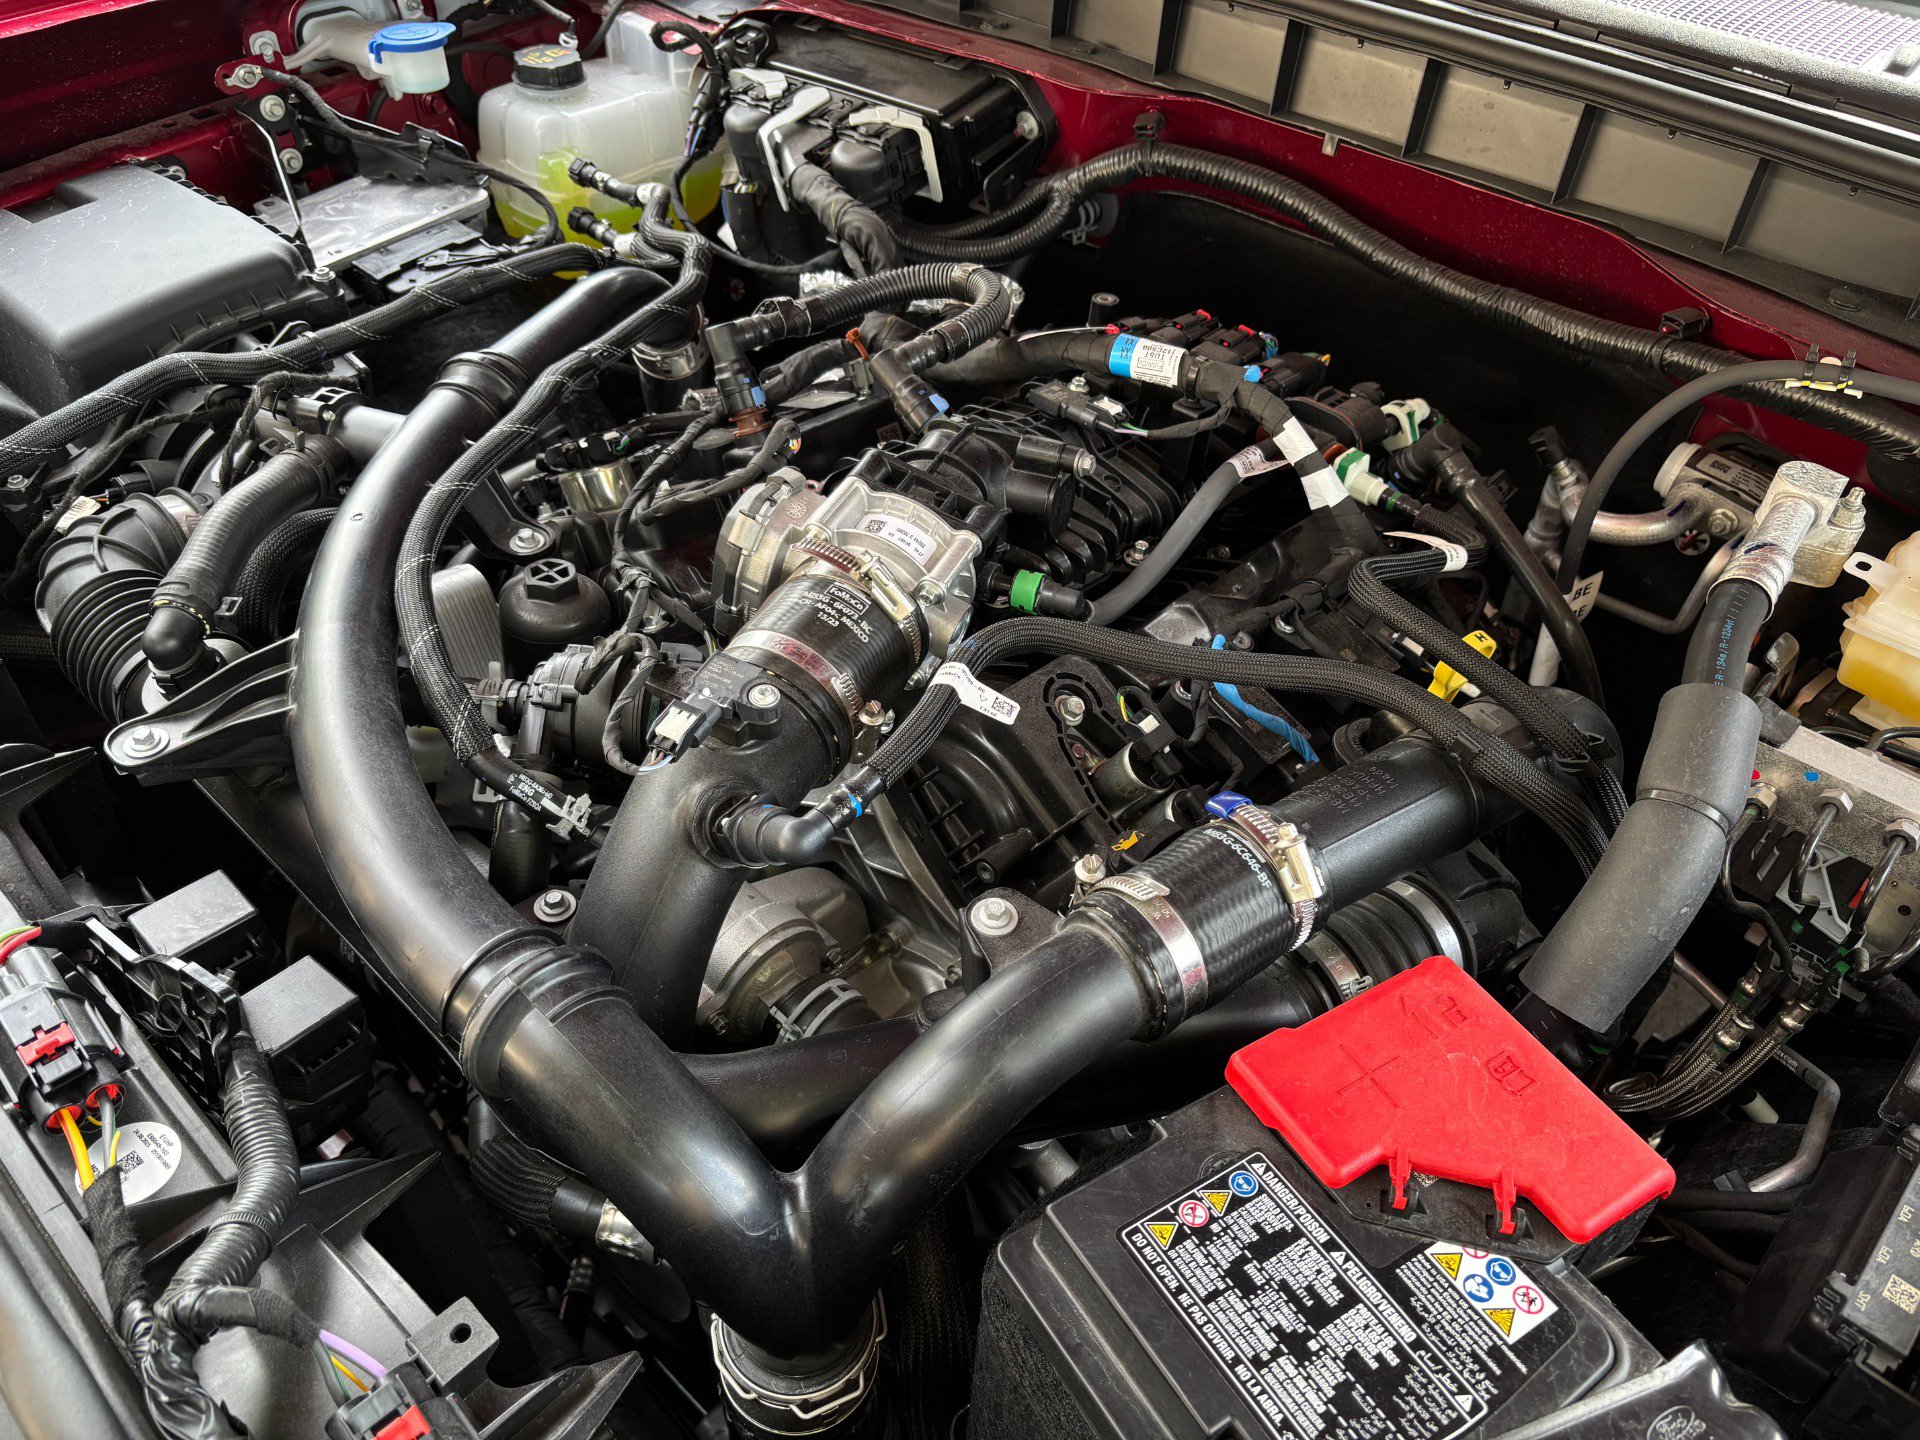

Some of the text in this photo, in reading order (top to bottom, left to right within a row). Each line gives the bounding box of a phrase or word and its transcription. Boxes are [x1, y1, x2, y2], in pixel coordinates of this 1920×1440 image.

[829, 586, 864, 610] FoMoCo
[1572, 582, 1593, 600] BE
[817, 611, 839, 627] 15/23
[840, 615, 870, 643] MEXICO
[508, 785, 528, 801] FoMoCo
[517, 781, 535, 796] ENG
[1203, 827, 1272, 889] MB3G-6C646-BF
[1237, 1206, 1256, 1225] CAUSE
[1244, 1201, 1275, 1234] GASES CAN
[1251, 1197, 1283, 1231] EXPLOSIVE
[1258, 1192, 1280, 1214] SHIELD
[1261, 1170, 1330, 1244] DANGER/POISON
[1209, 1222, 1242, 1257] NO SPARKS
[1223, 1214, 1252, 1246] OR INJURY.
[1230, 1210, 1259, 1241] BLINDNESS
[1174, 1243, 1216, 1292] CAUSE BLINDNESS
[1182, 1238, 1226, 1290] SULFURIC ACID CAN
[1206, 1243, 1231, 1270] SMOKING
[1213, 1239, 1235, 1262] FLAMES
[1275, 1251, 1309, 1288] CAUSER DES
[1290, 1241, 1344, 1301] LES LES GAZ
[1297, 1237, 1339, 1280] SE PROTÉGER
[1166, 1248, 1209, 1299] OR SEVERE BURNS.
[1268, 1256, 1301, 1290] BLESSURES
[1295, 1288, 1307, 1298] ET
[1283, 1246, 1338, 1308] EXPLOSIFS PEUVENT
[1243, 1262, 1307, 1333] ÉVITEZ LES ÉTINCELLES
[1250, 1297, 1278, 1327] DE FUMER
[1257, 1292, 1294, 1333] LES FLAMMES
[1340, 1260, 1418, 1343] PELIGRO/VENENO
[1394, 1267, 1473, 1354] estadounidenses e importados.
[1400, 1264, 1429, 1296] Fabricardo
[1425, 1292, 1436, 1304] en
[1433, 1300, 1444, 1312] los
[1441, 1309, 1454, 1323] EE.
[1450, 1320, 1464, 1334] UU.
[1461, 1331, 1474, 1345] con
[1410, 1256, 1435, 1283] Fabriqué
[1431, 1280, 1445, 1294] aux
[1468, 1319, 1483, 1335] avec
[1480, 1332, 1494, 1347] des
[1416, 1252, 1433, 1270] Made
[1429, 1267, 1438, 1276] in
[1434, 1273, 1449, 1289] USA
[1446, 1286, 1460, 1301] with
[1457, 1298, 1469, 1310] US
[1465, 1306, 1480, 1321] and
[1476, 1317, 1503, 1347] imported
[1854, 1290, 1871, 1312] SHT
[1130, 1231, 1288, 1427] DO NOT OPEN. NE PAS OUVRIR. NO LA ABRA.
[1206, 1300, 1257, 1360] DES BRÛLURES GRAVES.
[1215, 1295, 1271, 1361] PEUT CAUSER LA CÉCITÉ OU
[1223, 1289, 1277, 1351] L'ACIDE SULFURIQUE
[1325, 1322, 1354, 1352] DAÑOS O
[1339, 1312, 1380, 1356] EXPLOSIVOS
[1354, 1302, 1397, 1349] PROTEJA LOS
[1456, 1316, 1465, 1326] et
[1305, 1338, 1347, 1382] NO CHISPAS
[1318, 1327, 1349, 1360] CEGUERA.
[1332, 1317, 1380, 1370] PUEDEN CAUSAR
[1363, 1327, 1381, 1344] LOS
[1375, 1340, 1401, 1367] GASES
[1258, 1367, 1269, 1375] O
[1275, 1353, 1301, 1378] ÁCIDO
[1291, 1373, 1330, 1414] SULFÚRICO
[1304, 1363, 1336, 1398] CIGARROS
[1312, 1359, 1338, 1386] FLAMAS
[1262, 1372, 1299, 1413] QUEMADURAS
[1267, 1361, 1288, 1382] PUEDE
[1281, 1378, 1305, 1404] CAUSAR
[1299, 1401, 1326, 1431] CEGUERA
[1292, 1409, 1320, 1439] FUERTES.
